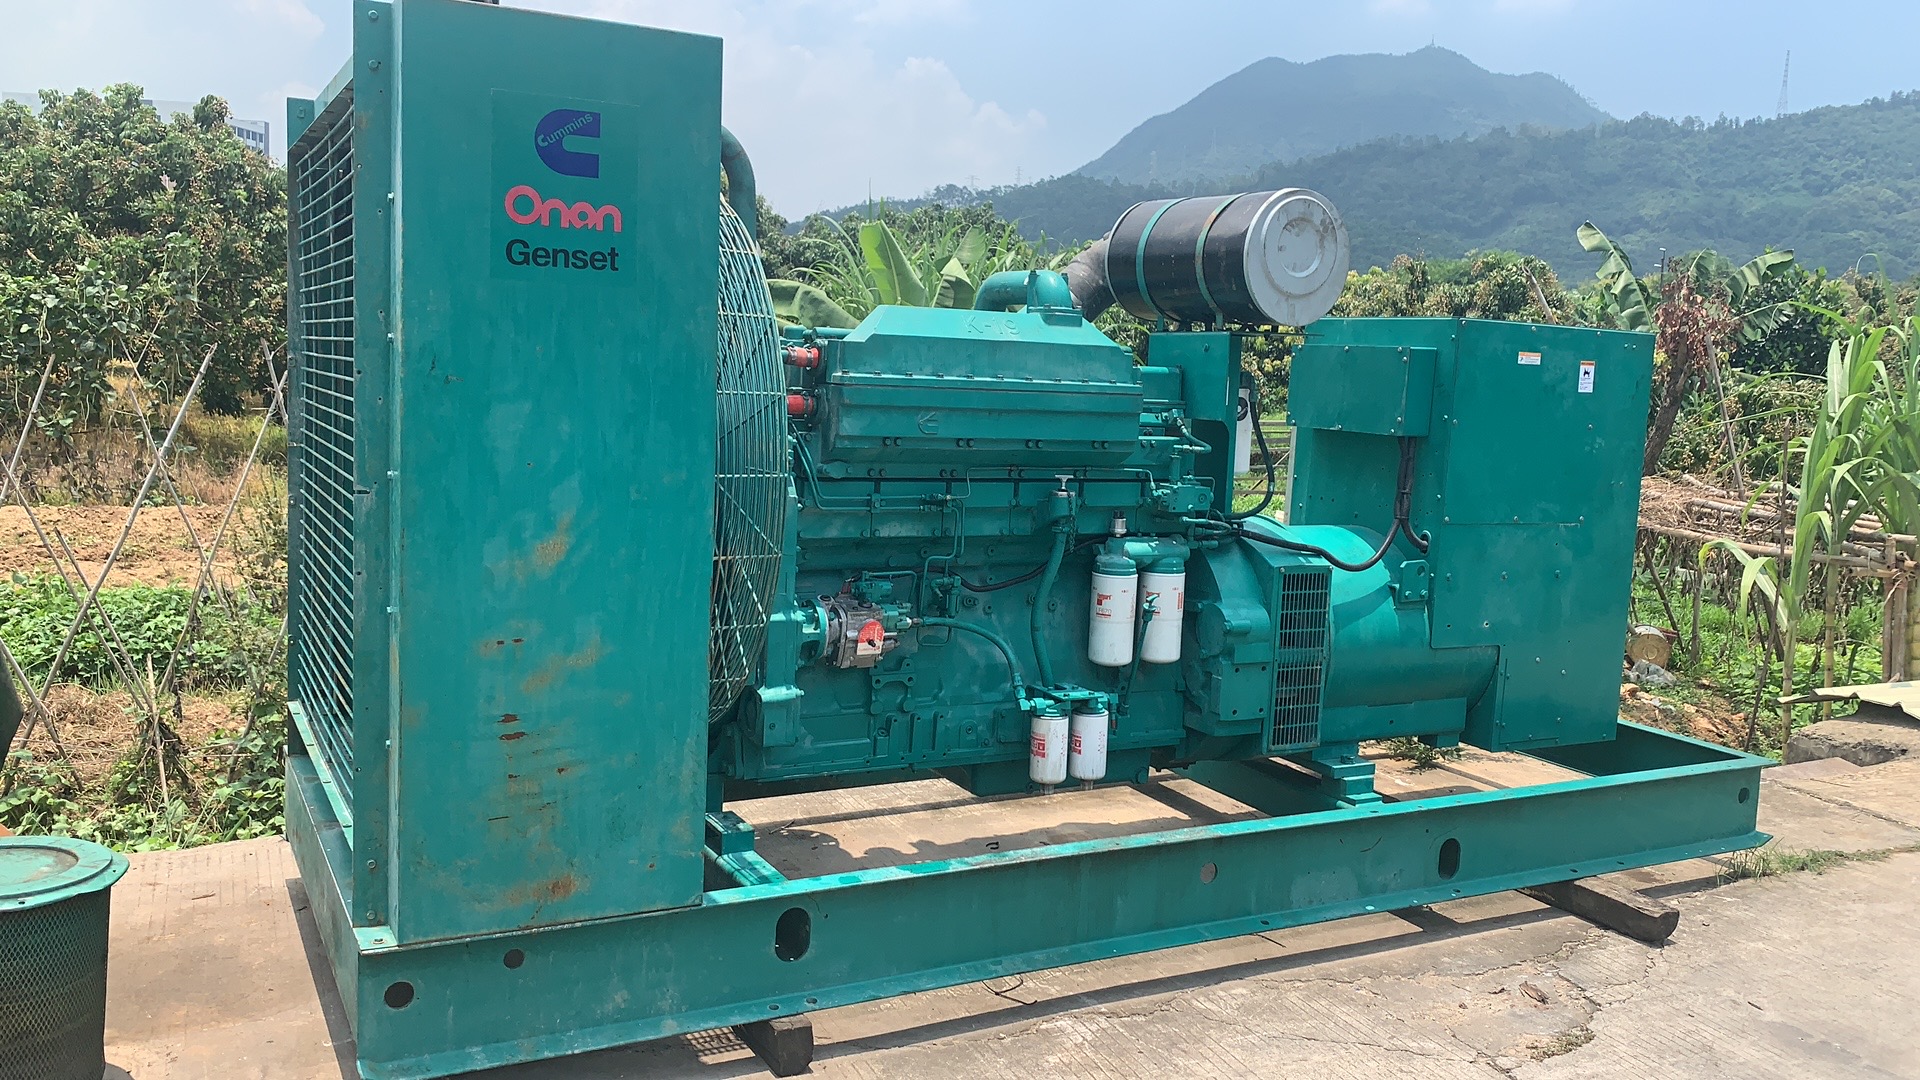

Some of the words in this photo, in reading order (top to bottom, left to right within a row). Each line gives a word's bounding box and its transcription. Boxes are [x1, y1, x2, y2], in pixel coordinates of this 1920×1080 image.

[537, 113, 593, 148] Cummins
[504, 185, 622, 233] Onan
[505, 239, 619, 272] Genset
[963, 316, 1020, 336] K-19
